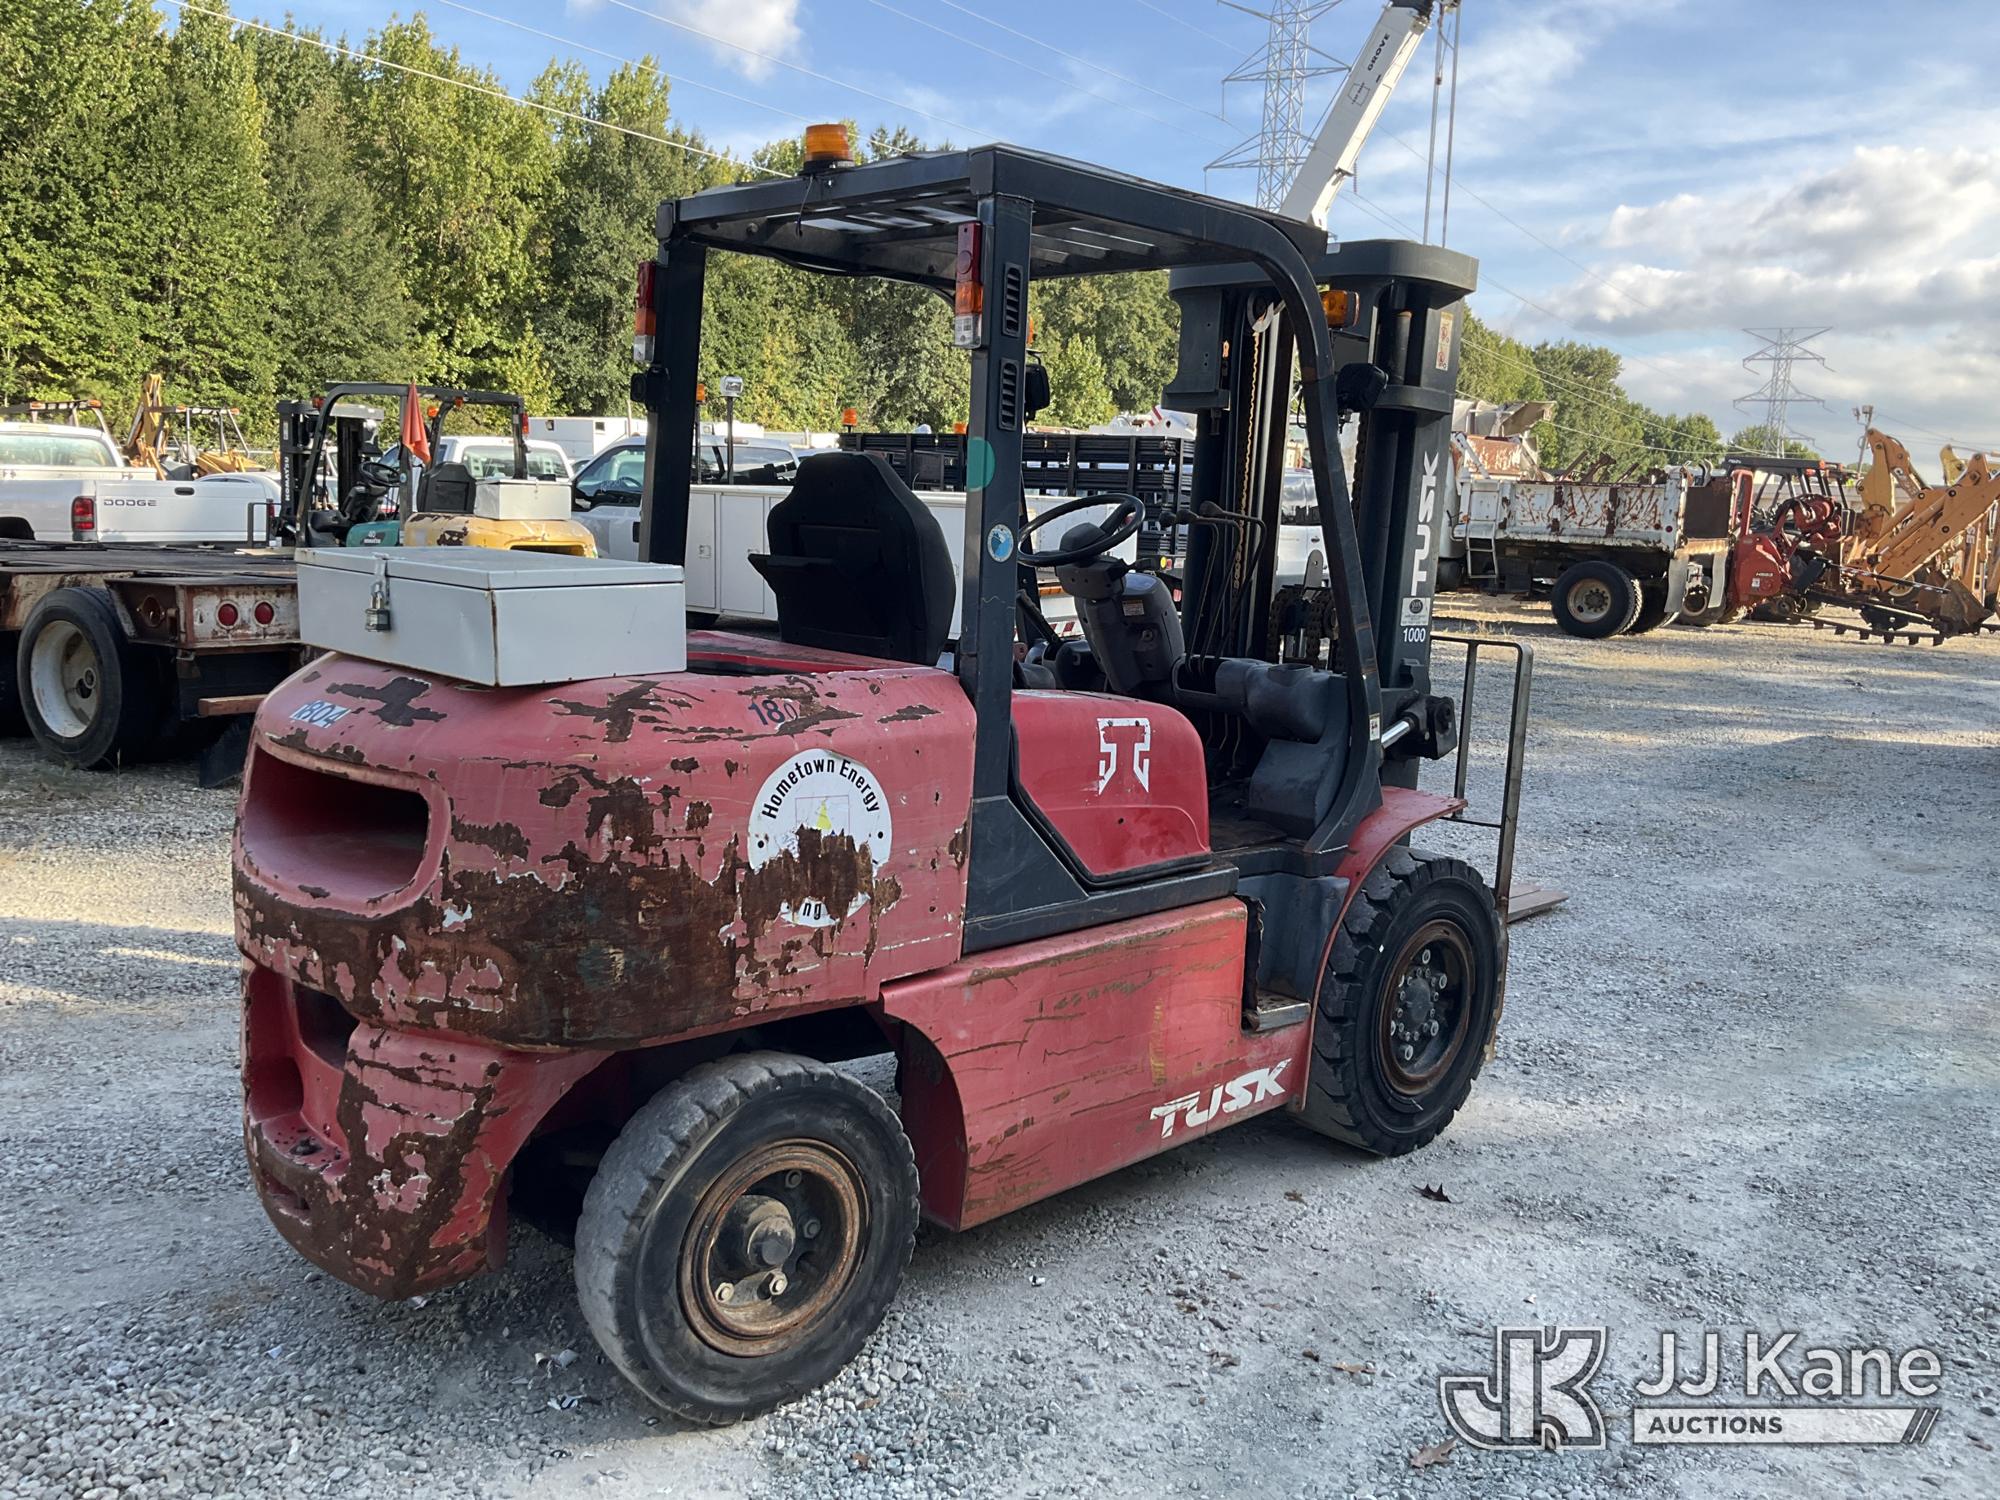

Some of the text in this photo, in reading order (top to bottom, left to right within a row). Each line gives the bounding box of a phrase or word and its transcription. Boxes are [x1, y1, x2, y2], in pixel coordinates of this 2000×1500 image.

[1367, 33, 1390, 71] GROVE
[103, 499, 157, 507] DODGE
[1411, 451, 1439, 597] TUSK
[1403, 627, 1426, 642] 1000
[761, 758, 880, 819] Hometown Energy
[1150, 1058, 1292, 1139] TUSK
